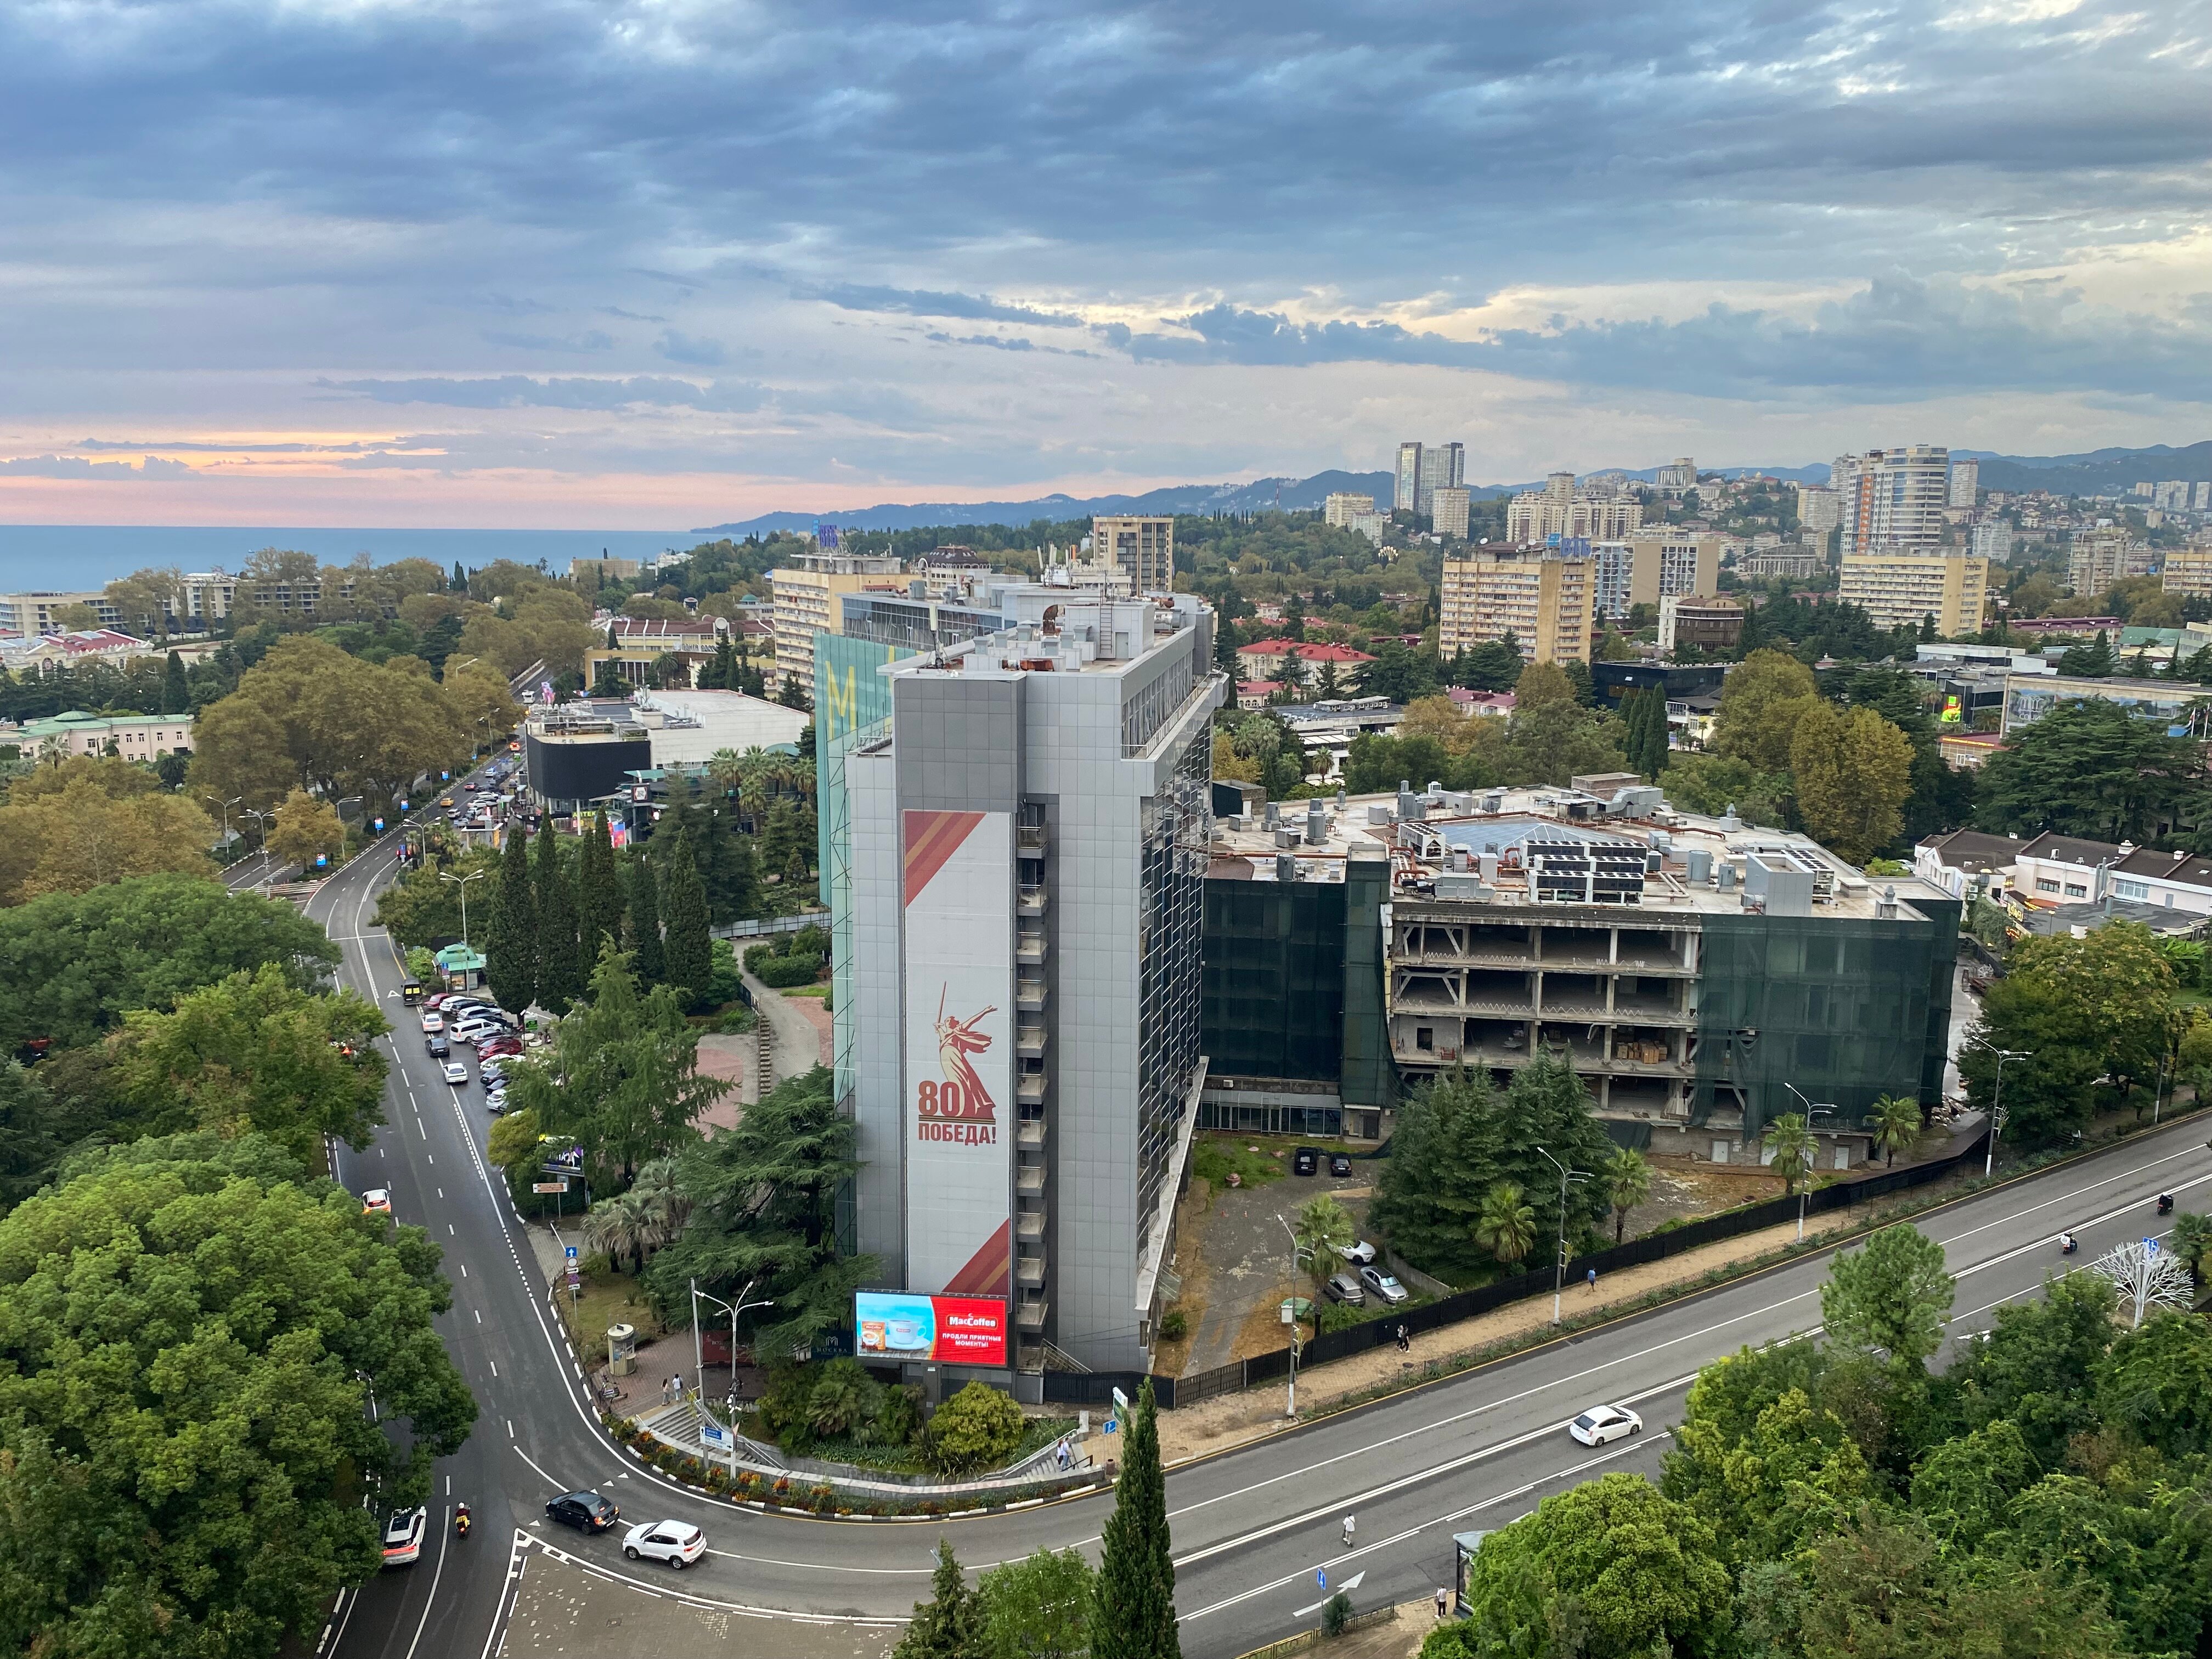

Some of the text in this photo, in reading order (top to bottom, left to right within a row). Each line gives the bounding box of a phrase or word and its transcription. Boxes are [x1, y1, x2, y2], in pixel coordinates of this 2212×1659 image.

[1561, 538, 1592, 557] ВТБ
[918, 1080, 960, 1117] 80
[918, 1122, 996, 1146] ПОБЕДА!
[949, 1316, 996, 1327] MacCoffee
